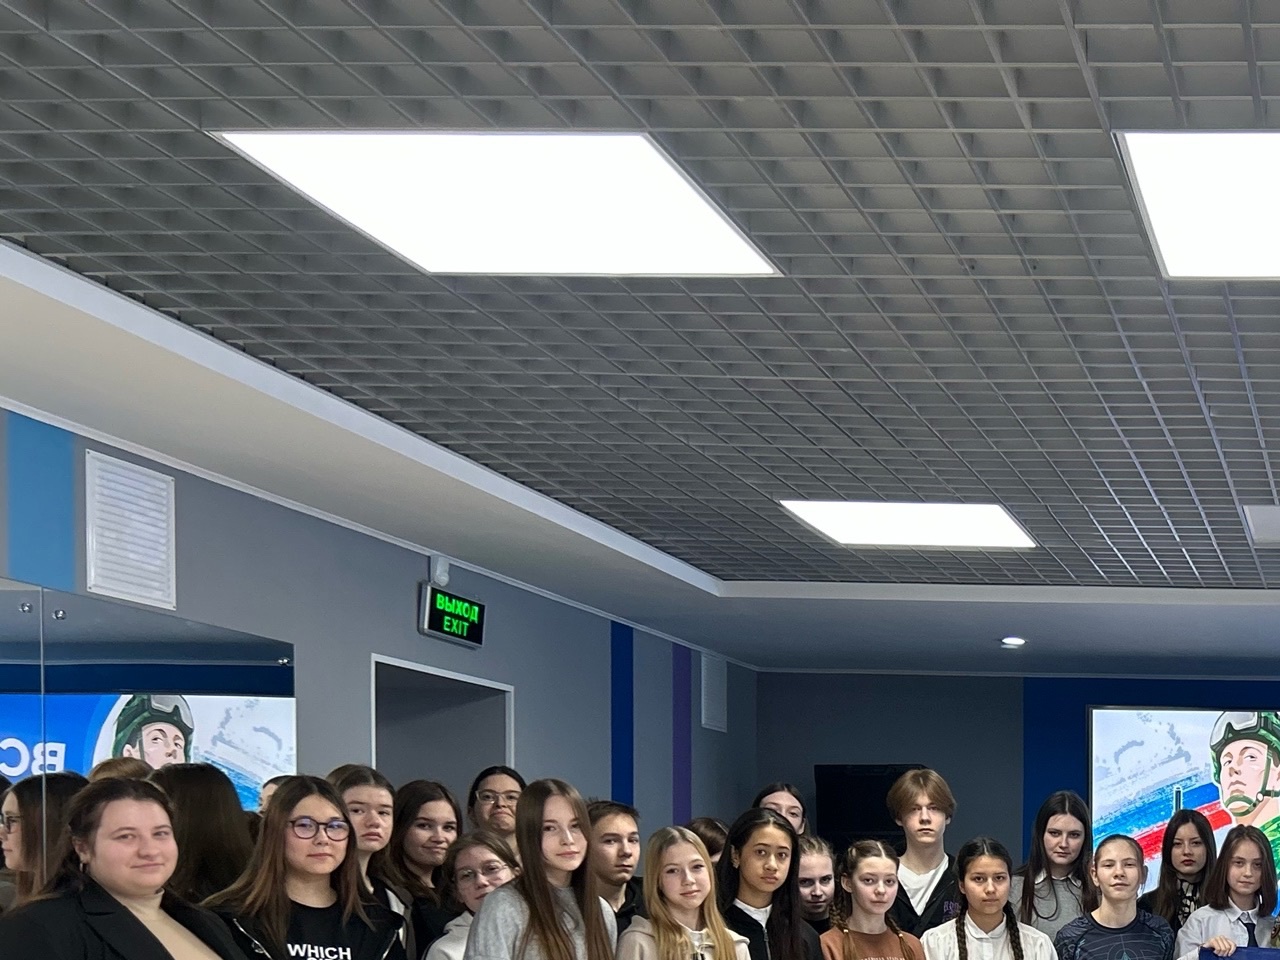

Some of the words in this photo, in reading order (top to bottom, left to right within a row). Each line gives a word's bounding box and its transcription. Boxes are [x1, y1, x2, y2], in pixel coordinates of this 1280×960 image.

[436, 593, 479, 624] ВЫХОД
[443, 615, 469, 637] EXIT
[287, 943, 352, 960] WHICH
